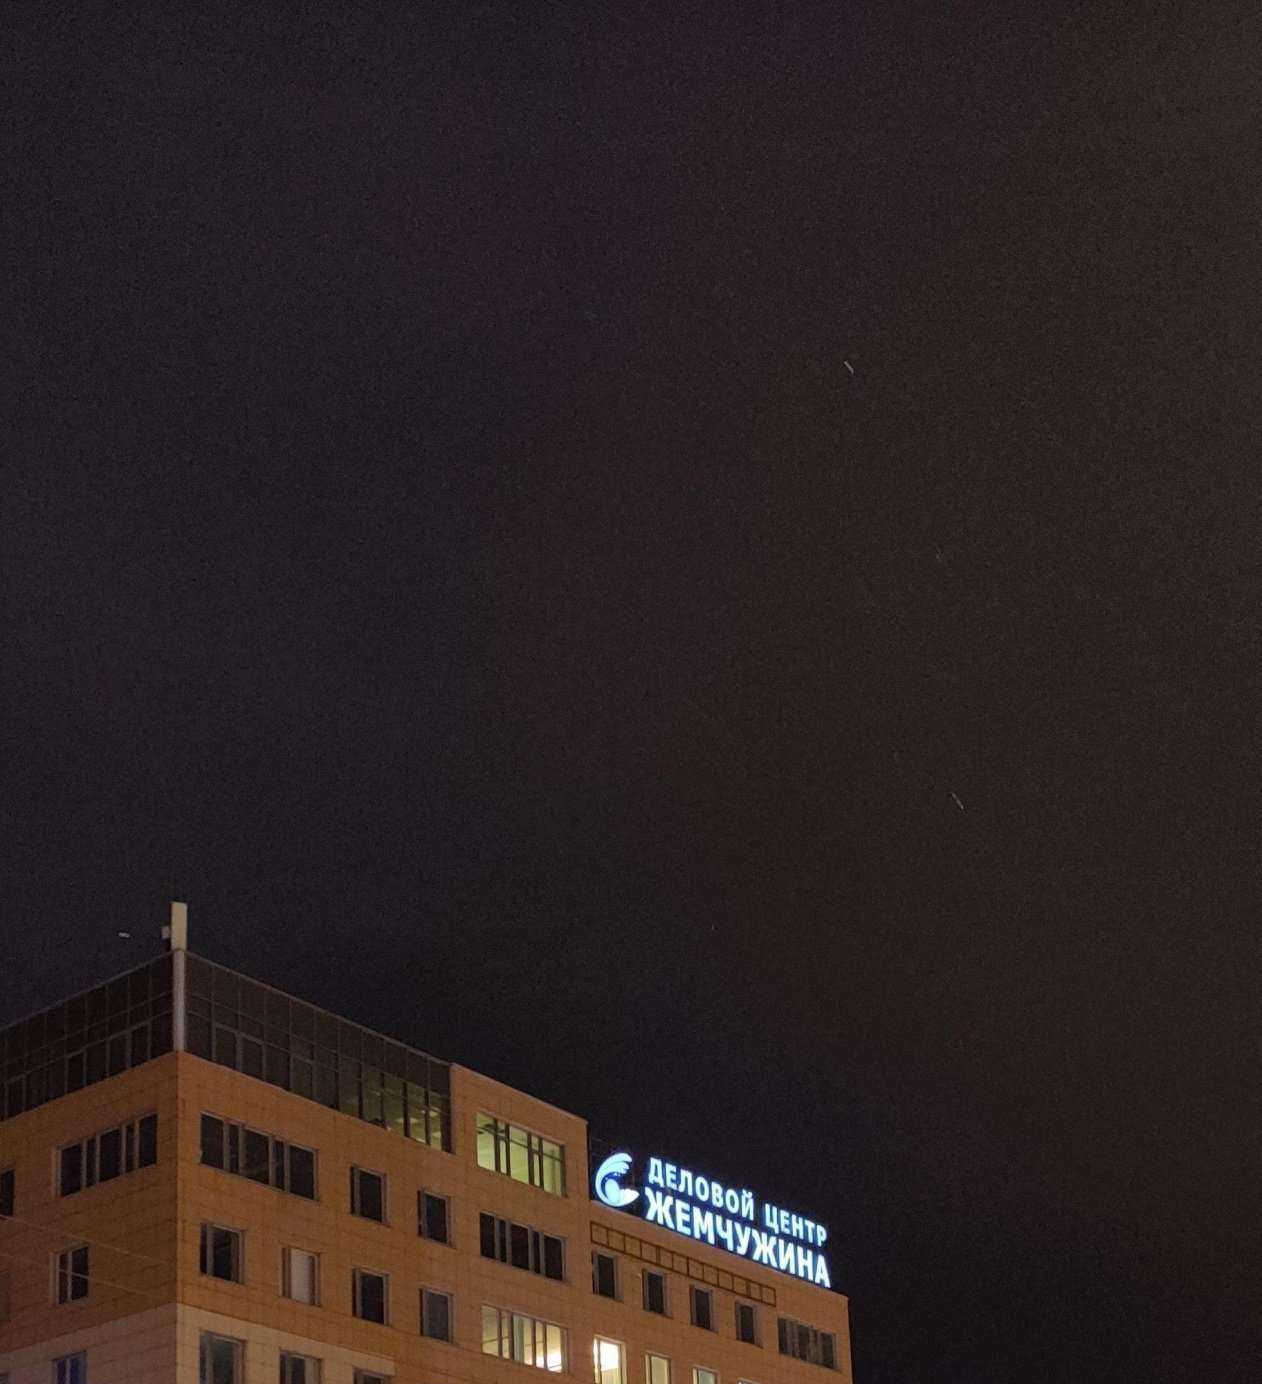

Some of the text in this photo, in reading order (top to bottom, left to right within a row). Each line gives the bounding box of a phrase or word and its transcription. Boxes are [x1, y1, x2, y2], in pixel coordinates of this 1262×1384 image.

[643, 1186, 832, 1289] ЖЕМЧУЖИНА
[647, 1157, 828, 1247] ДЕЛОВОЙ ЦЕНТР
